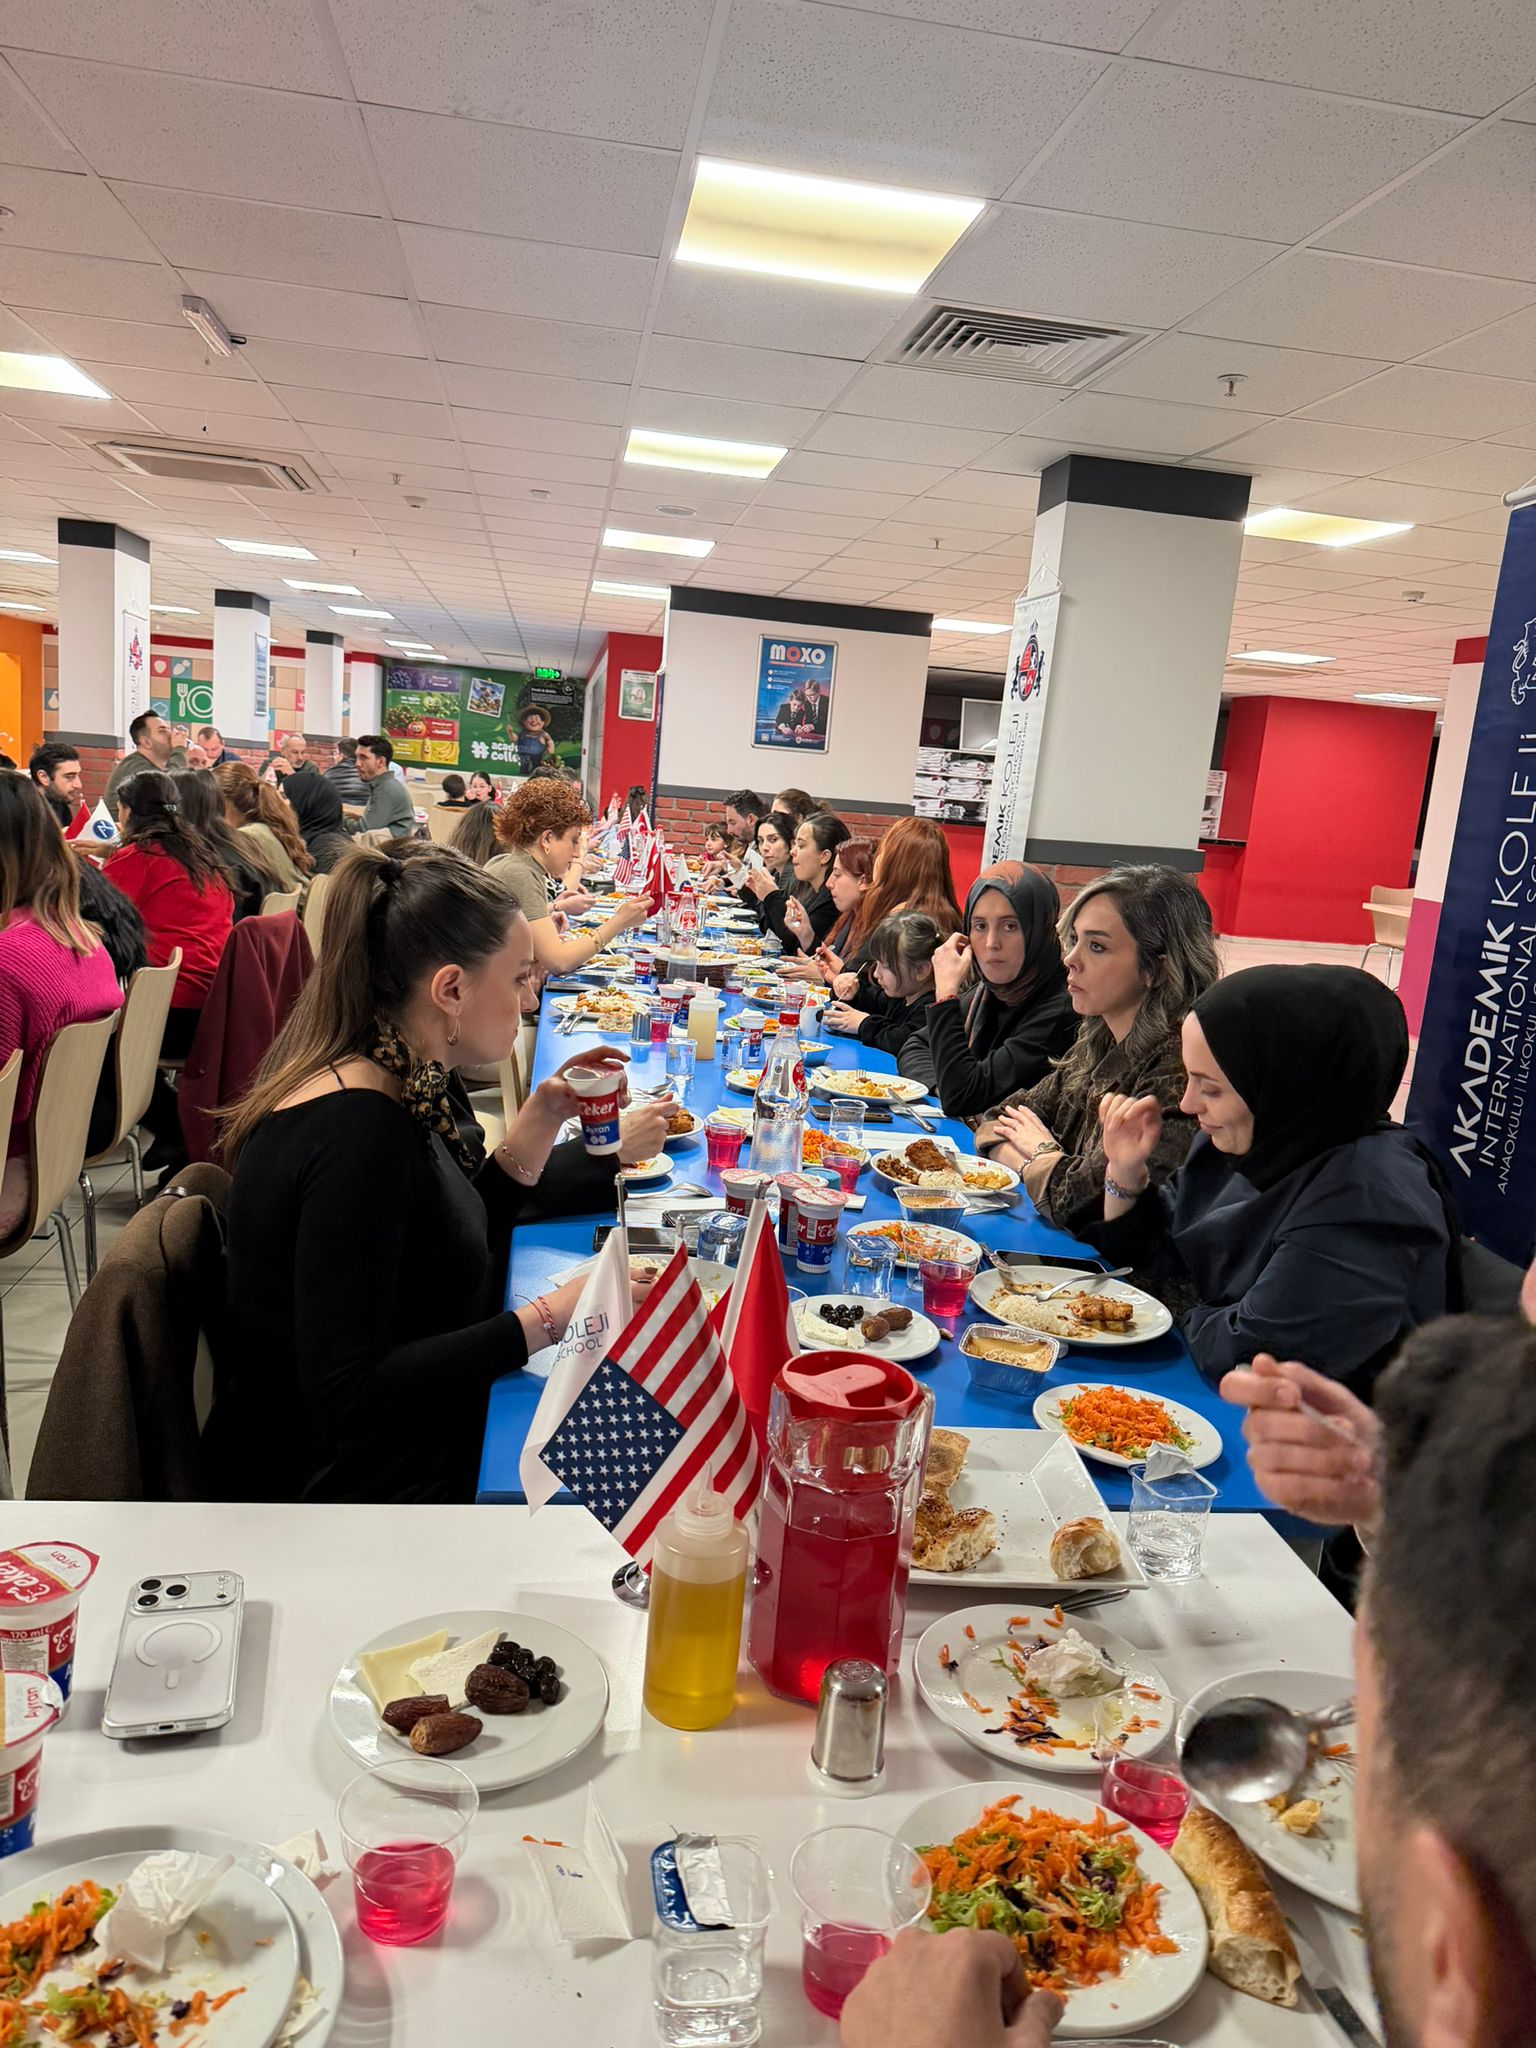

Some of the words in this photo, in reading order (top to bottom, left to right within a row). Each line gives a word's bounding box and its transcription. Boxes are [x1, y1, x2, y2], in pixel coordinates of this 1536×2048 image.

[1478, 922, 1536, 1167] INTERNATIONAL
[1497, 1094, 1525, 1195] ANAOKULU
[10, 1631, 28, 1639] 170
[30, 1628, 44, 1638] ml
[24, 1687, 42, 1718] Ayran
